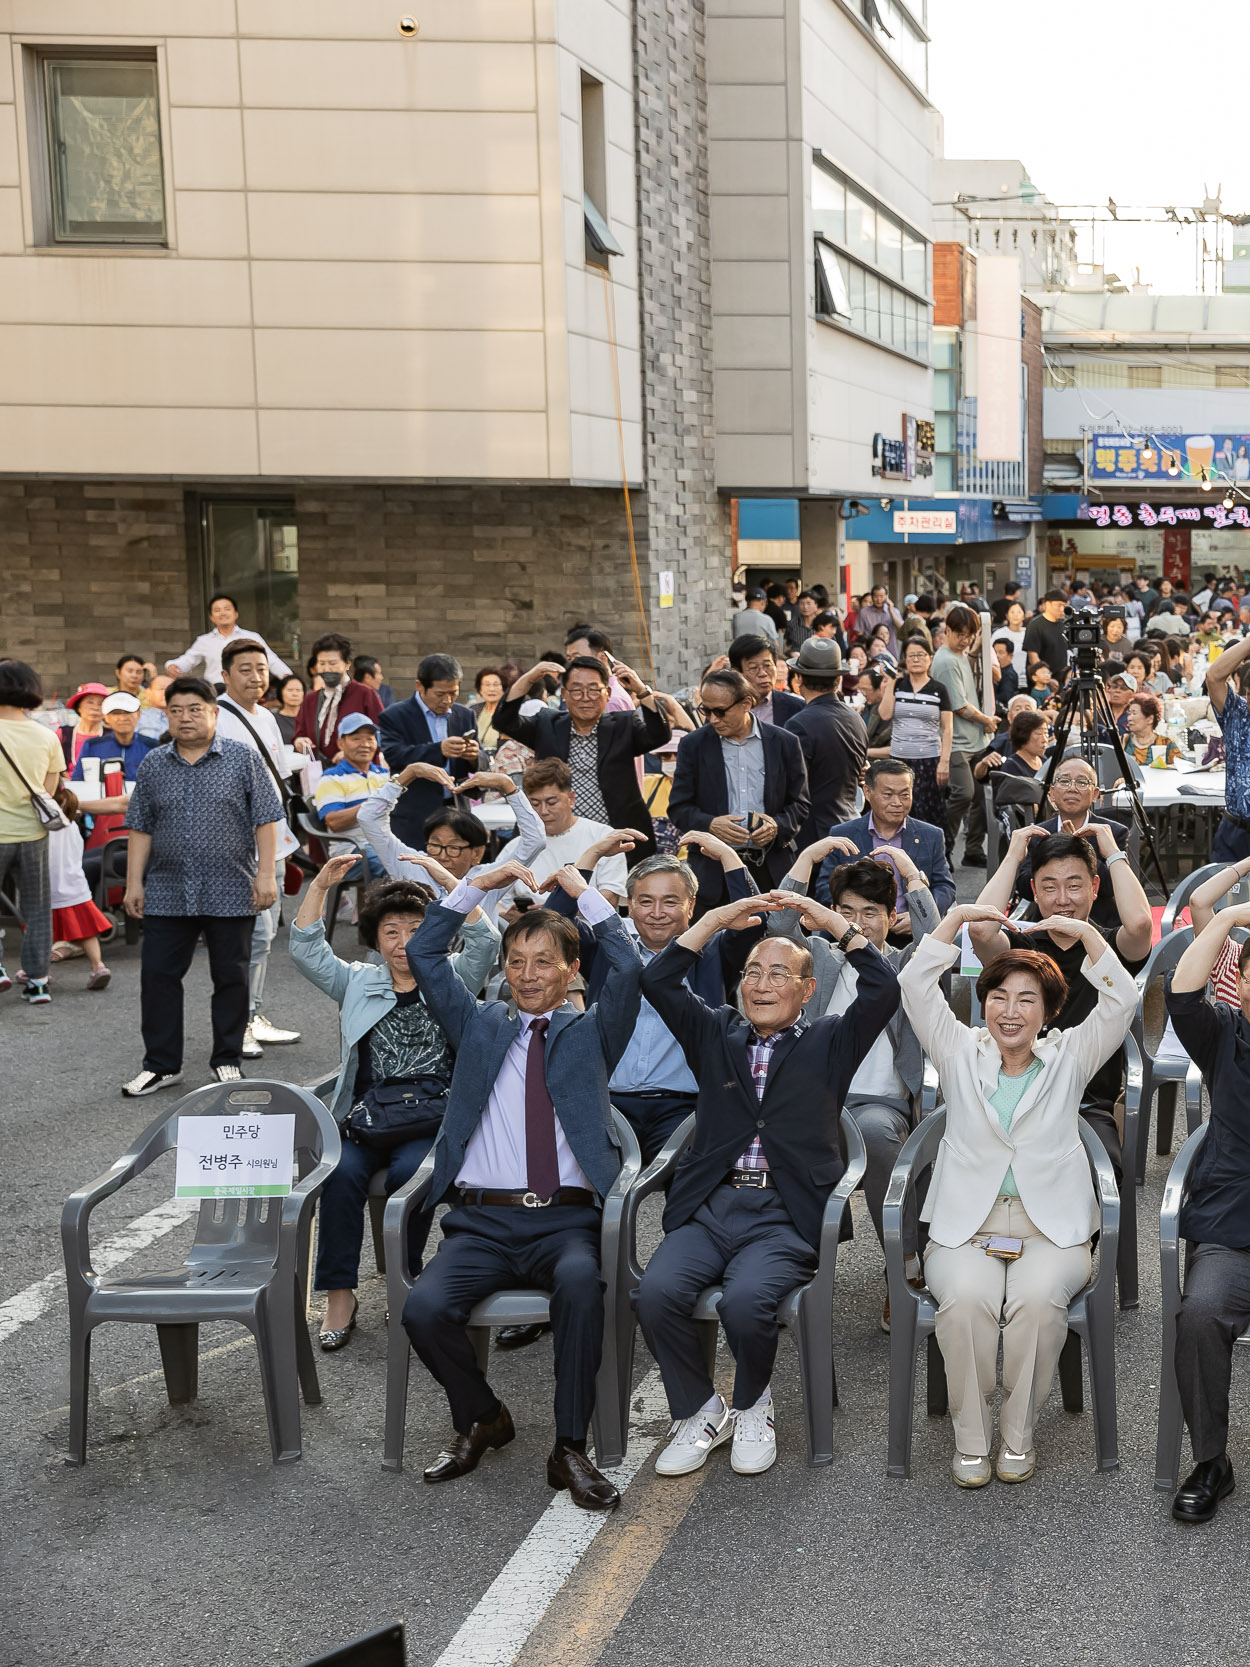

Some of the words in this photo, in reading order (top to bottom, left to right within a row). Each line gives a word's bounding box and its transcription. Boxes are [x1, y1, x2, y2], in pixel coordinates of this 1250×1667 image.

[897, 516, 954, 529] 주차관리실
[222, 1124, 261, 1140] 민주당
[198, 1154, 244, 1171] 전병주
[246, 1158, 279, 1169] 시의원님
